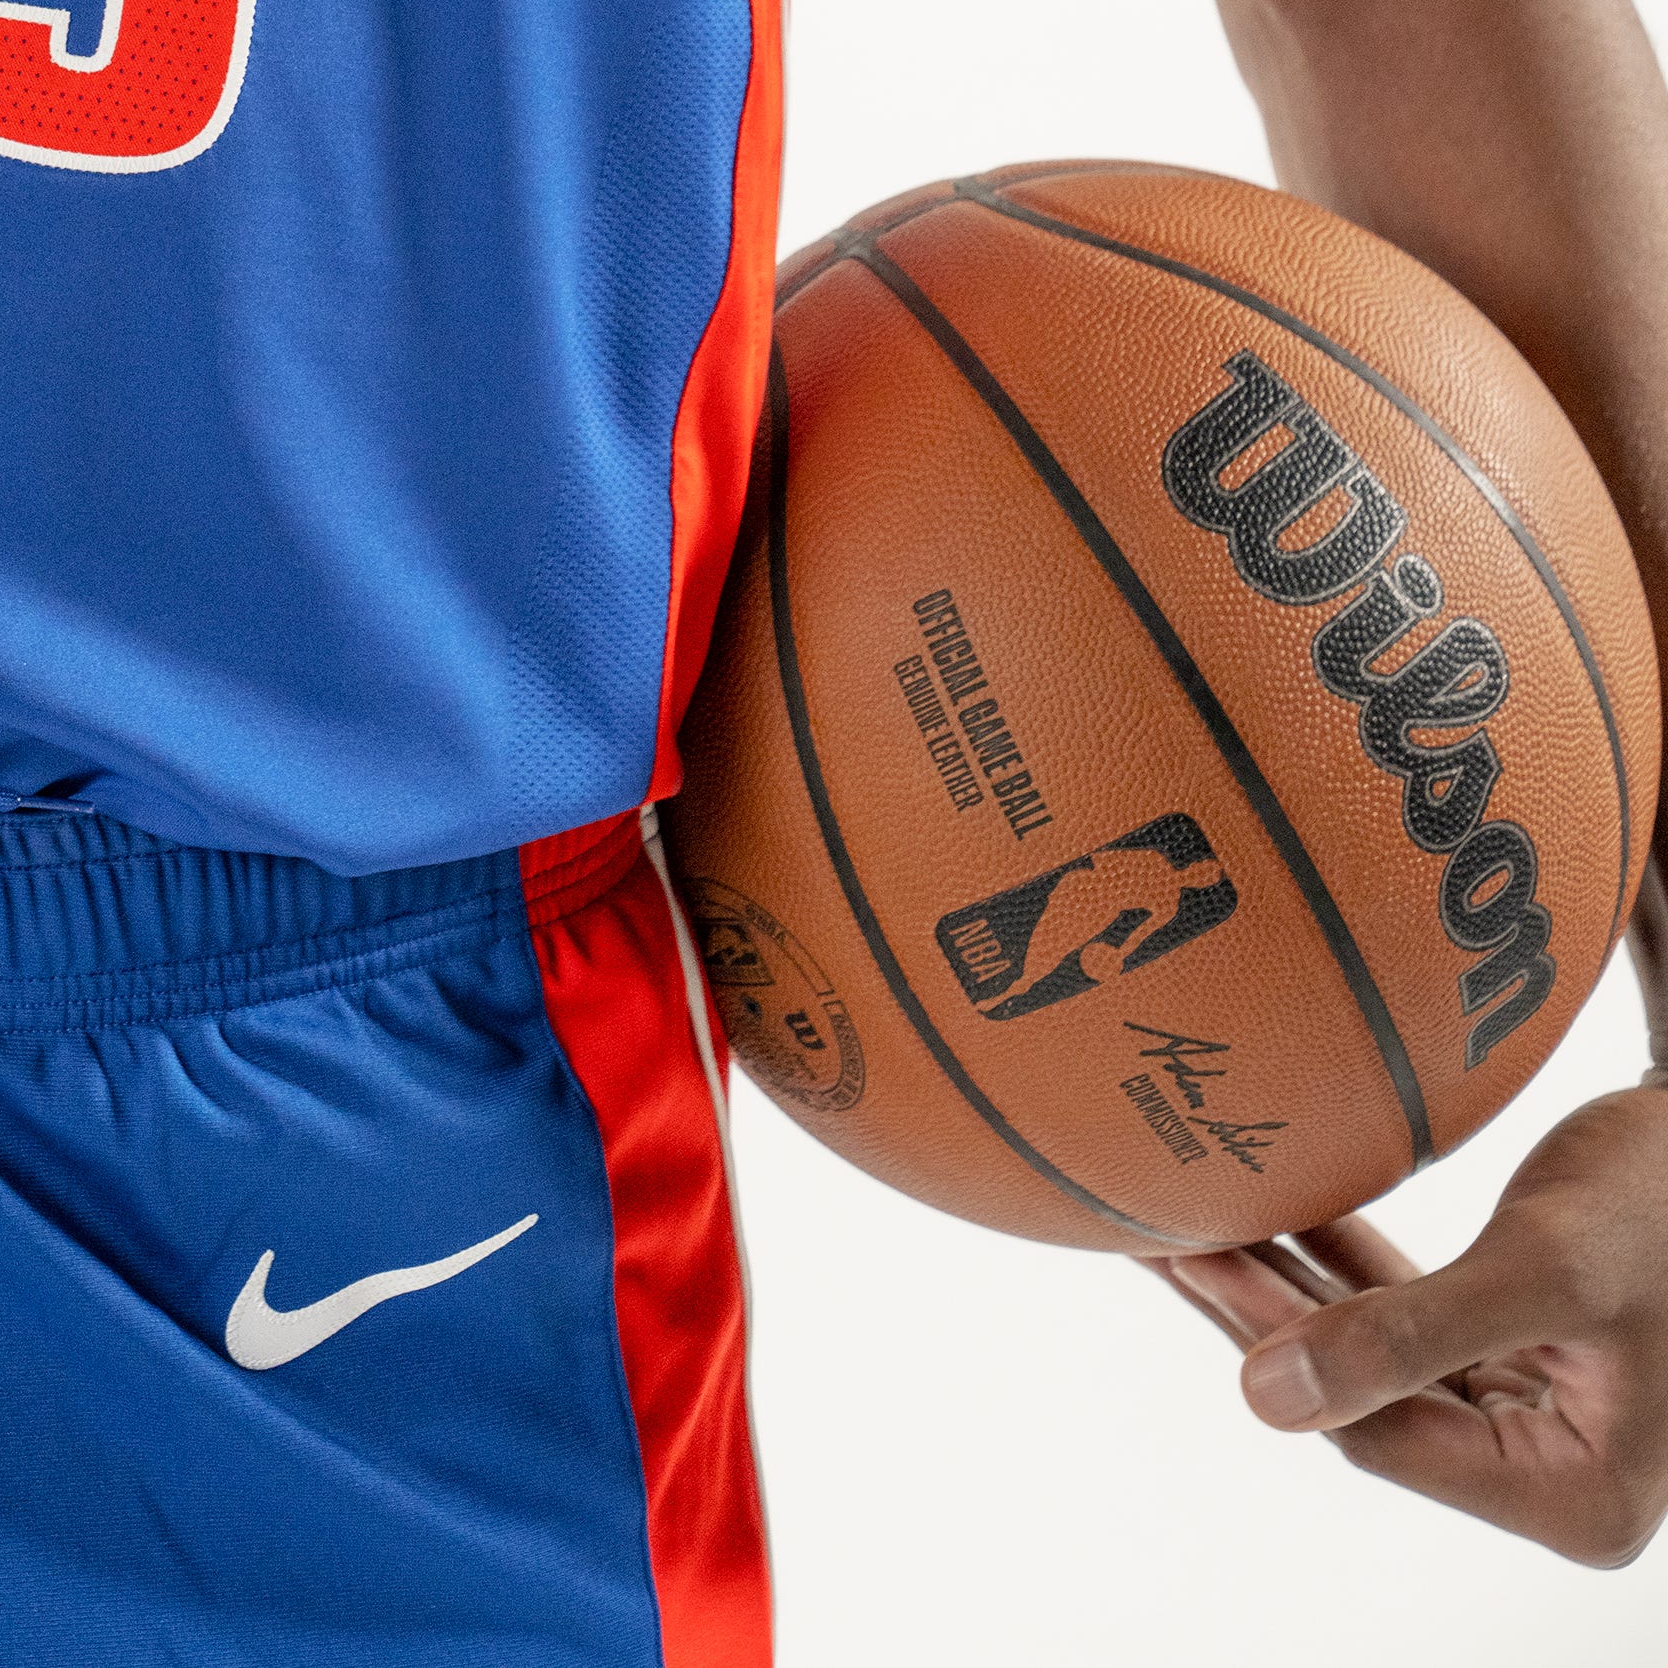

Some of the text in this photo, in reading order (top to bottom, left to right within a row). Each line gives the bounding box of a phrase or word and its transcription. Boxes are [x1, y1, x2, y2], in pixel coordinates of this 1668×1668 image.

[893, 654, 985, 813] GENUINE LEATHER
[912, 588, 1053, 841] OFFICIAL GAME BALL
[1161, 348, 1557, 1070] Wilson
[948, 918, 1011, 985] NBA
[1119, 1072, 1209, 1165] COMMISSIONER
